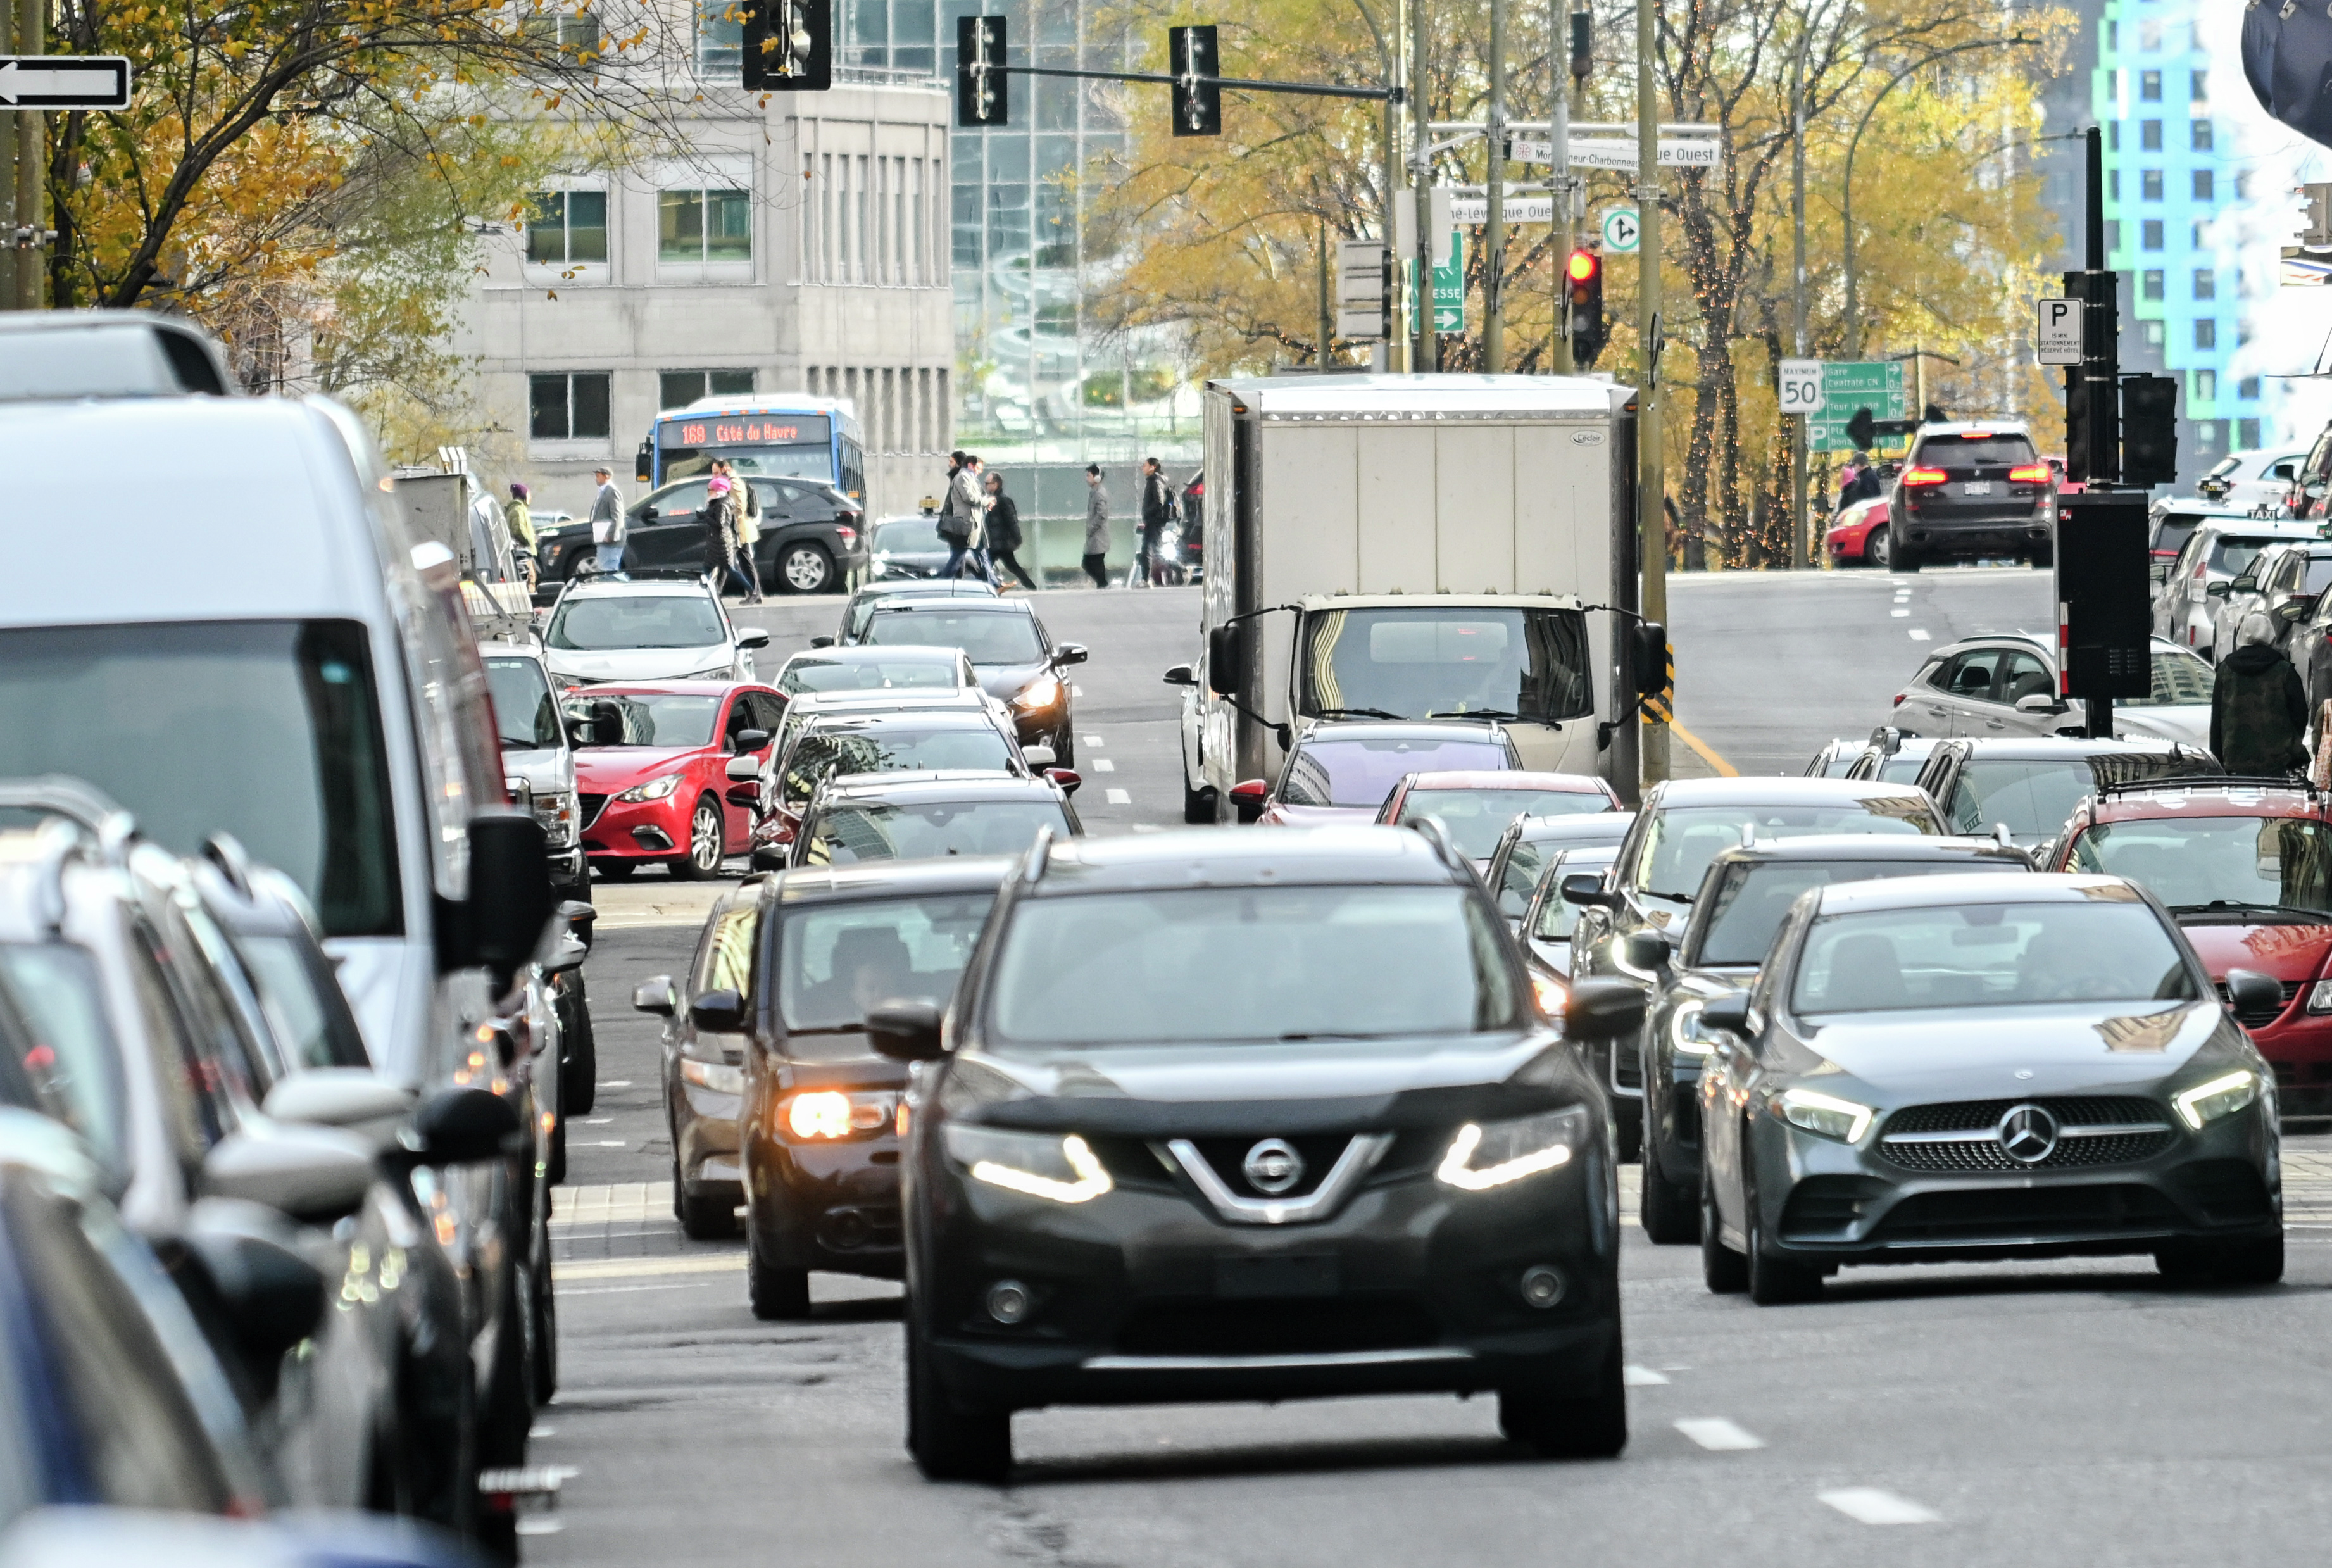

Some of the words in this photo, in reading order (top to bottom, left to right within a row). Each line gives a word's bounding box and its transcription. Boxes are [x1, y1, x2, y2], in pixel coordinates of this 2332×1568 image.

[1535, 149, 1638, 168] Moneur-Charbonnea
[1677, 148, 1714, 161] Ouest
[1528, 206, 1551, 218] Oue
[1414, 289, 1462, 299] ESSE
[2052, 304, 2068, 327] P
[1828, 379, 1863, 387] Centrale
[1785, 381, 1816, 404] 50
[717, 425, 744, 442] Cité
[746, 424, 760, 441] du
[763, 422, 798, 440] Havre
[1831, 426, 1845, 435] Pla
[2249, 510, 2276, 520] TAXI
